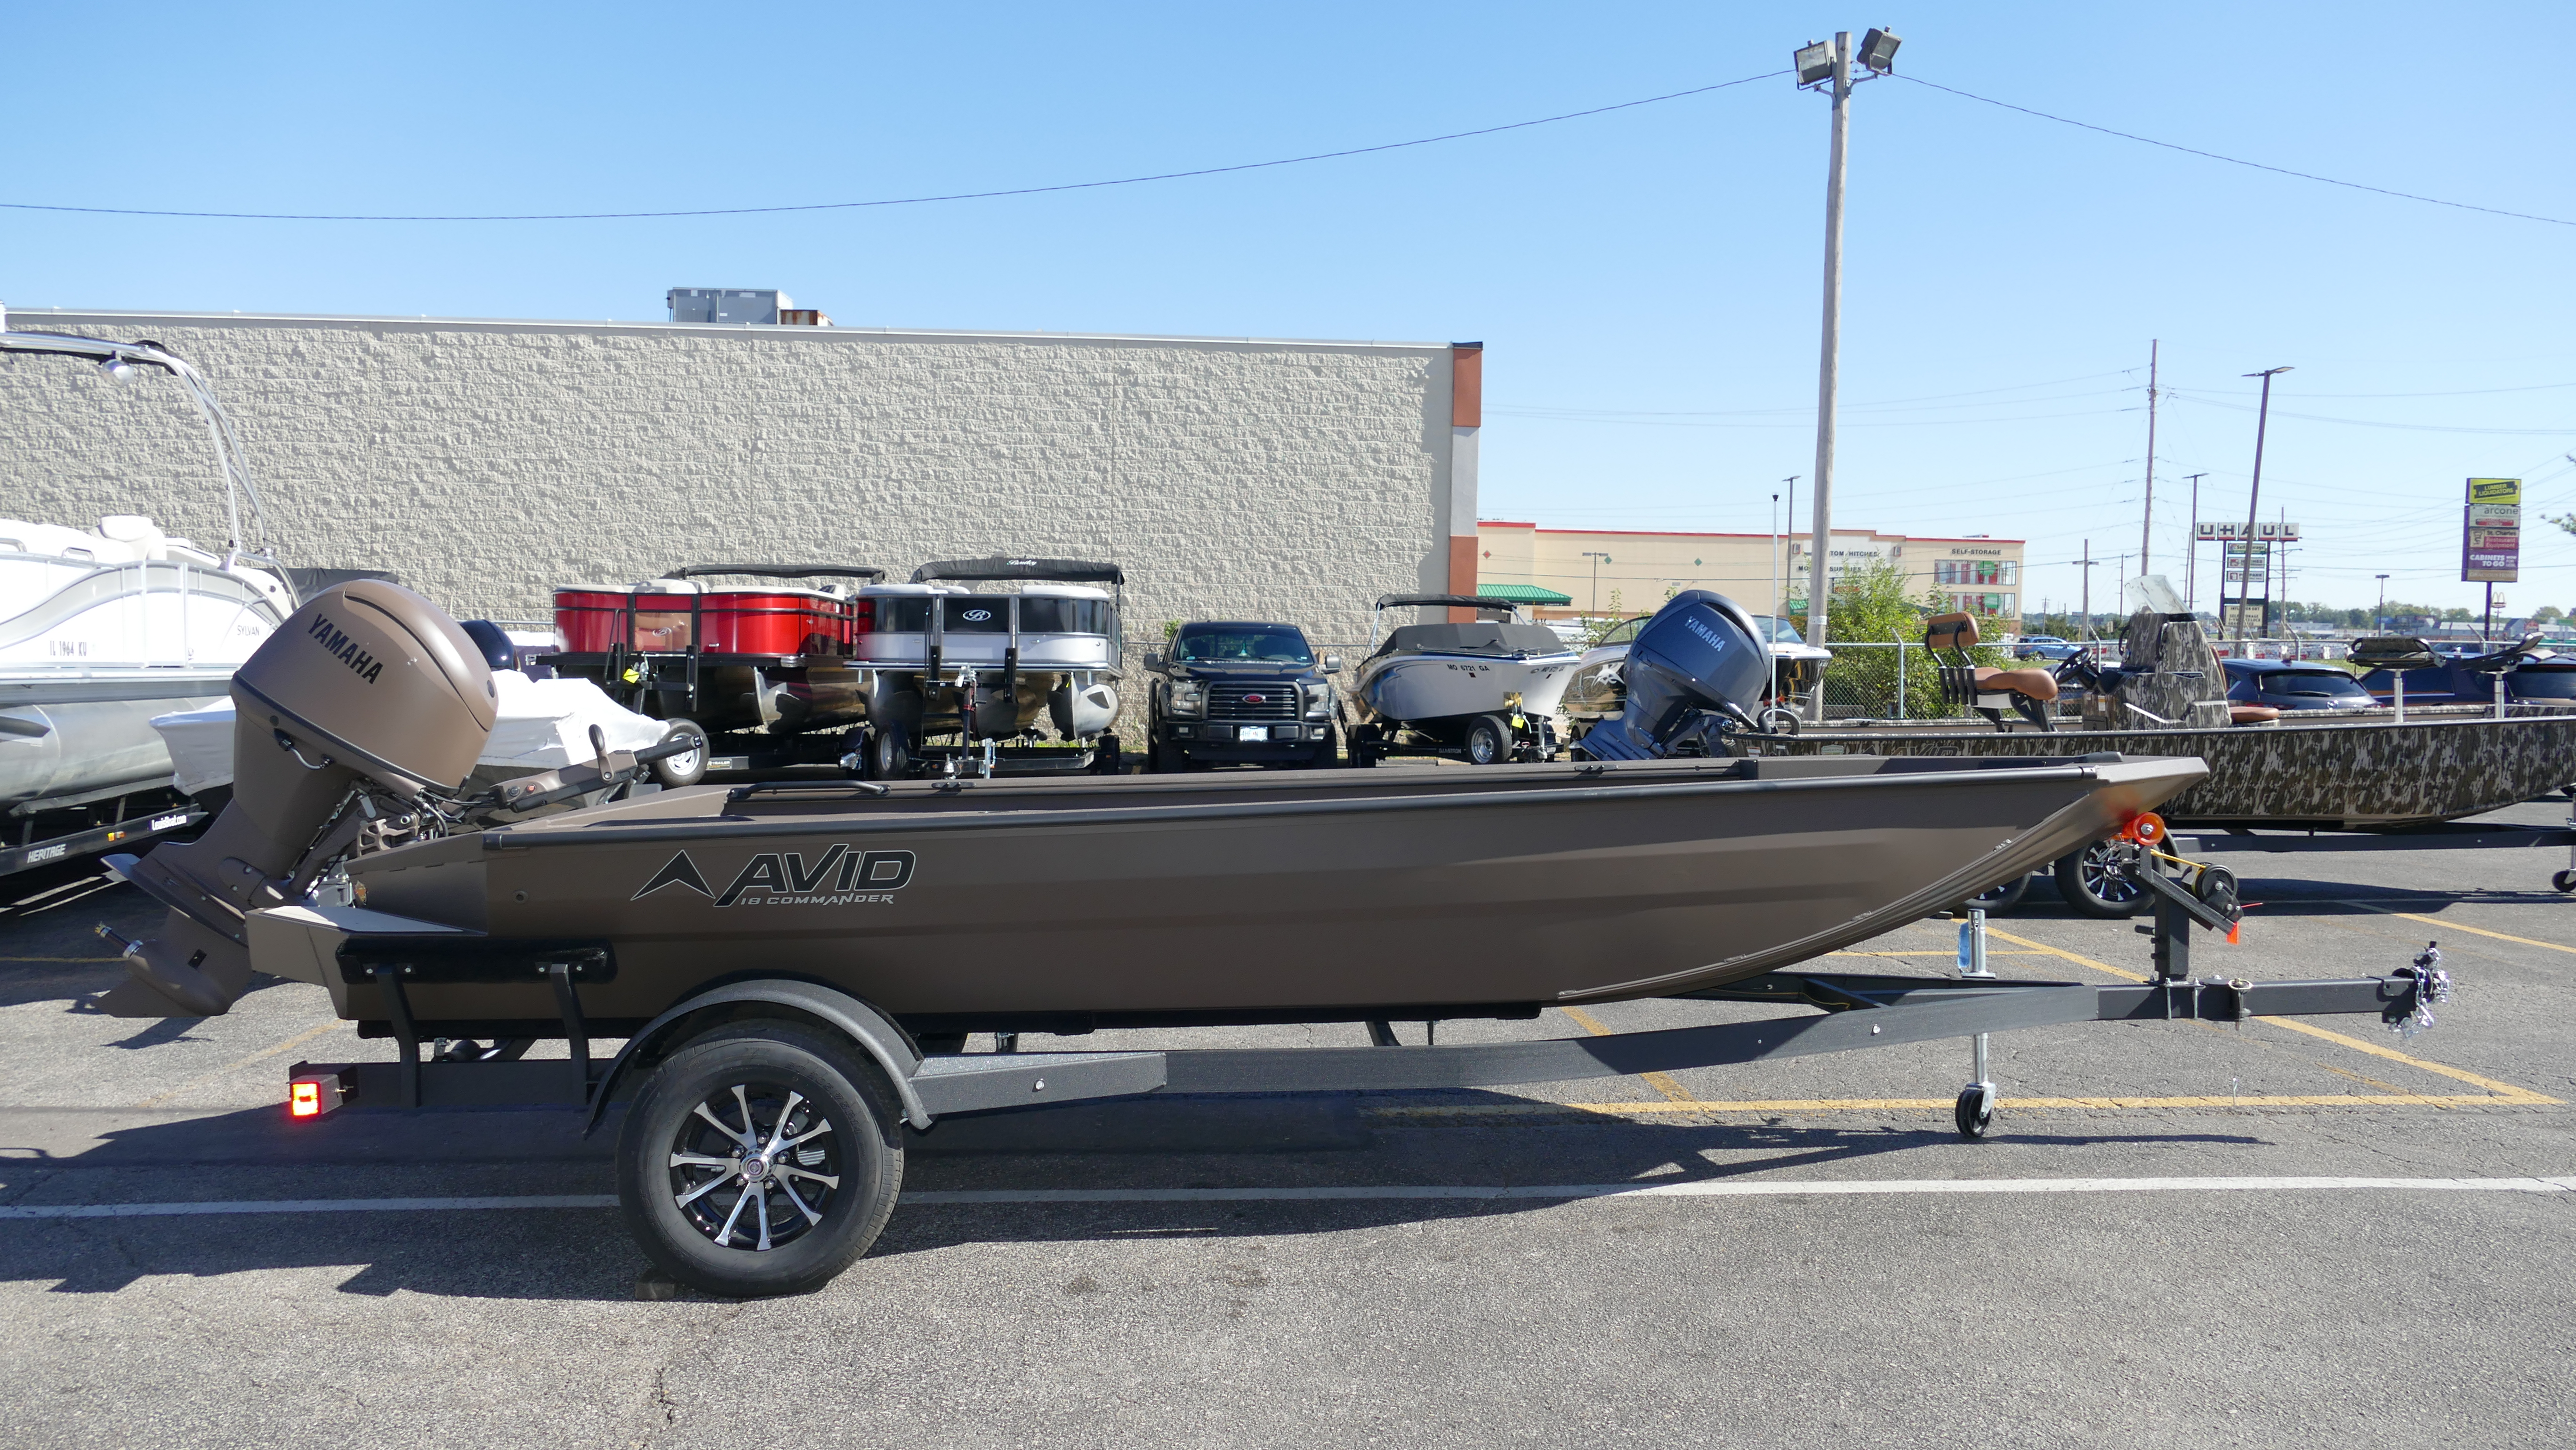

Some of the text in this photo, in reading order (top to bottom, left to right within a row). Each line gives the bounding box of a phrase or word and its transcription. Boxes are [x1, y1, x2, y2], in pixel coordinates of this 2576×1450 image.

[237, 625, 260, 636] SYLVAN
[1685, 616, 1726, 652] YAMAHA
[59, 641, 74, 656] 1964
[78, 642, 87, 657] KU
[308, 613, 384, 685] YAMAHA
[27, 844, 66, 863] HERITAGE
[713, 844, 916, 907] AVID
[741, 893, 894, 906] 18 COMMANDER
